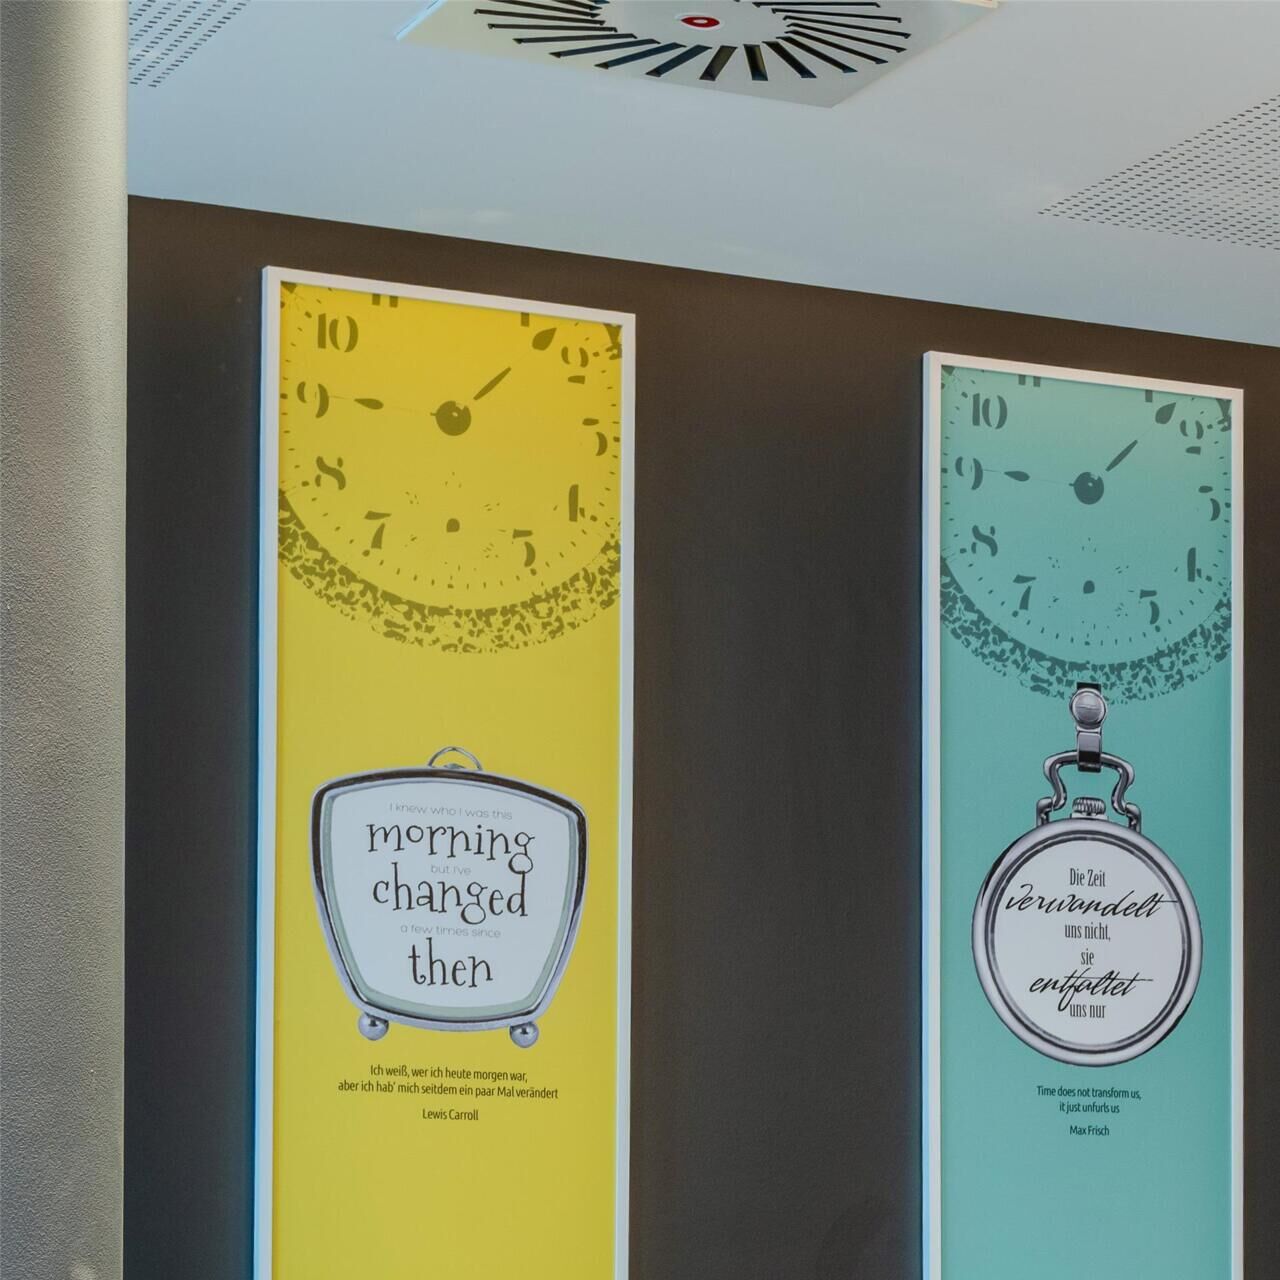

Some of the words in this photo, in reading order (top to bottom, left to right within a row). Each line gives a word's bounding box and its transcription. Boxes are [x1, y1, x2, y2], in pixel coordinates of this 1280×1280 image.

[317, 312, 359, 353] 10
[972, 393, 1008, 429] 10
[396, 803, 428, 815] knew
[430, 806, 456, 816] who
[465, 809, 489, 818] was
[492, 809, 513, 820] this
[366, 824, 535, 874] morning
[431, 864, 450, 875] but
[1069, 868, 1085, 887] Die
[1087, 868, 1106, 887] Zeit
[373, 862, 528, 925] changed
[411, 924, 433, 935] few
[436, 925, 469, 937] times
[471, 926, 501, 938] since
[1064, 923, 1082, 939] uns
[1084, 922, 1111, 941] nicht,
[408, 937, 493, 988] then
[1080, 948, 1095, 966] sie
[1029, 967, 1154, 1012] entfaltet
[1069, 1003, 1087, 1018] uns
[1089, 1004, 1106, 1019] nur
[370, 1064, 384, 1076] Ich
[411, 1068, 428, 1078] wer
[430, 1066, 444, 1078] ich
[445, 1067, 472, 1080] heute
[474, 1070, 509, 1082] morgen
[510, 1071, 528, 1084] war,
[338, 1080, 359, 1092] aber
[361, 1080, 374, 1092] ich
[397, 1082, 420, 1094] mich
[421, 1083, 458, 1095] seitdem
[459, 1084, 474, 1096] ein
[475, 1086, 495, 1098] paar
[497, 1085, 515, 1098] Mal
[515, 1086, 559, 1099] verändert
[1037, 1085, 1056, 1097] Time
[1057, 1085, 1076, 1098] does
[1077, 1087, 1091, 1098] not
[1091, 1087, 1130, 1099] transform
[422, 1108, 448, 1120] Lewis
[449, 1108, 479, 1121] Carroll
[1059, 1101, 1065, 1112] it
[1066, 1101, 1081, 1115] just
[1110, 1103, 1120, 1114] us
[1069, 1124, 1087, 1136] Max
[1087, 1125, 1110, 1137] Frisch
